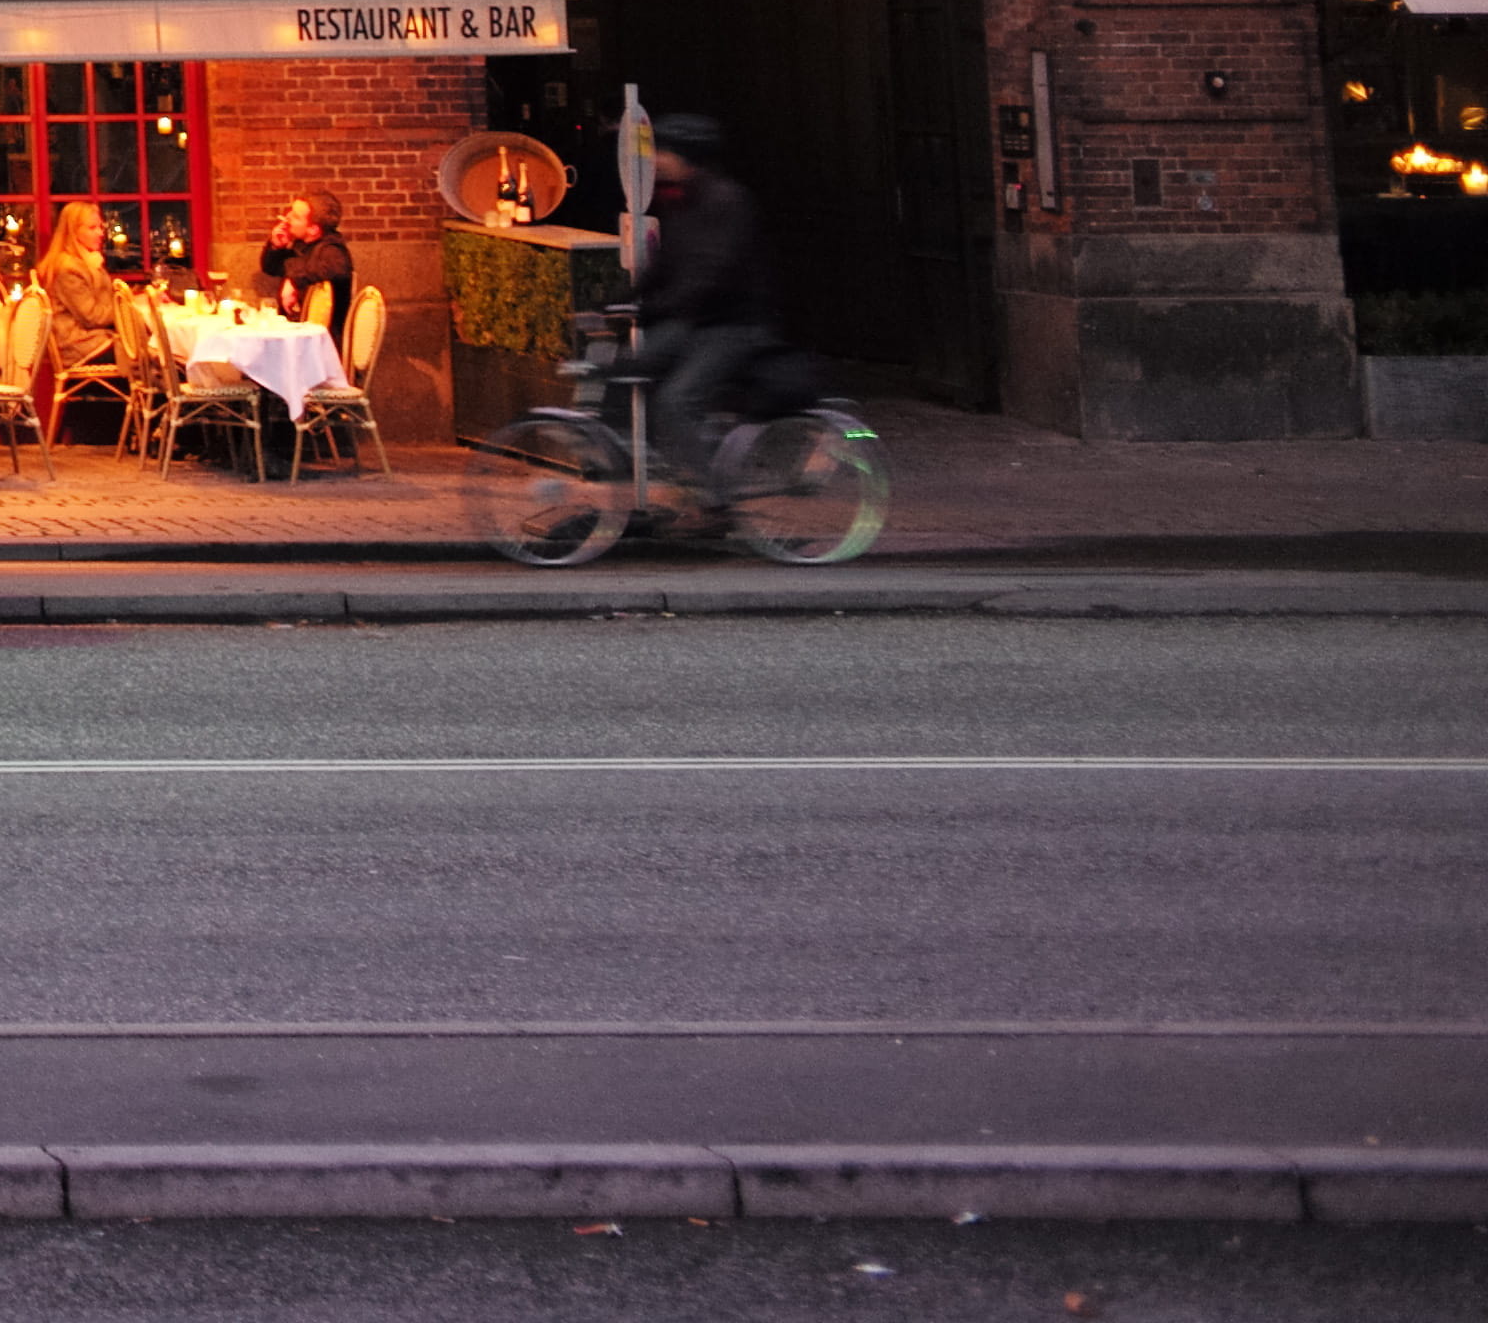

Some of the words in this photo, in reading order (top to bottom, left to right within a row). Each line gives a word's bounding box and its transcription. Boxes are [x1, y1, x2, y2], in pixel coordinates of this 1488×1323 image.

[297, 7, 452, 41] RESTAURANT
[460, 8, 480, 39] &
[489, 5, 537, 39] BAR
